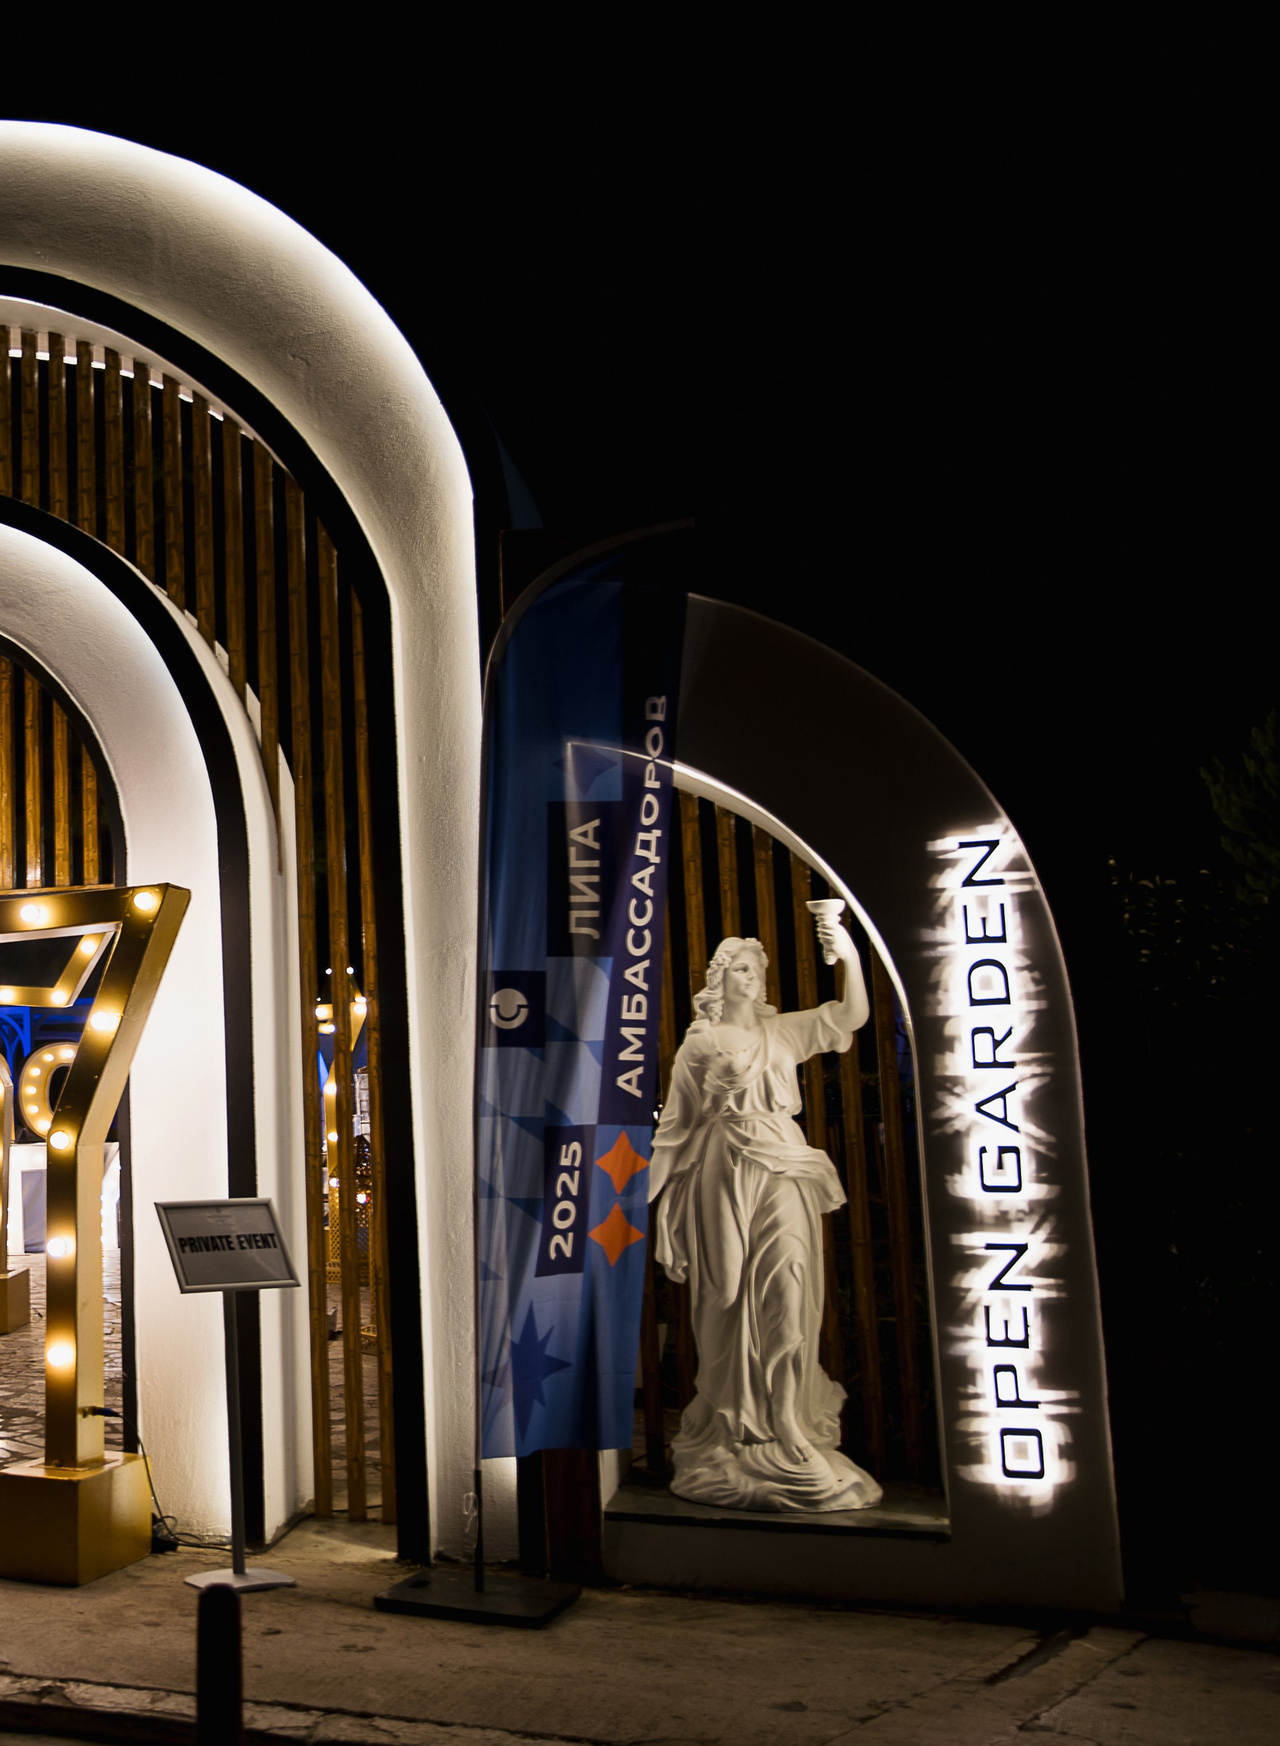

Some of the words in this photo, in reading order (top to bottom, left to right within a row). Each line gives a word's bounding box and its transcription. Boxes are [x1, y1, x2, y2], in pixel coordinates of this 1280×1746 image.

[568, 818, 601, 940] ЛИГА
[616, 694, 667, 1098] АМБАССАДОРОВ
[958, 839, 1022, 1192] GARDEN
[178, 1235, 235, 1253] PRIVATE
[236, 1233, 277, 1250] EVENT
[548, 1140, 582, 1261] 2025
[984, 1243, 1044, 1479] OPEN
